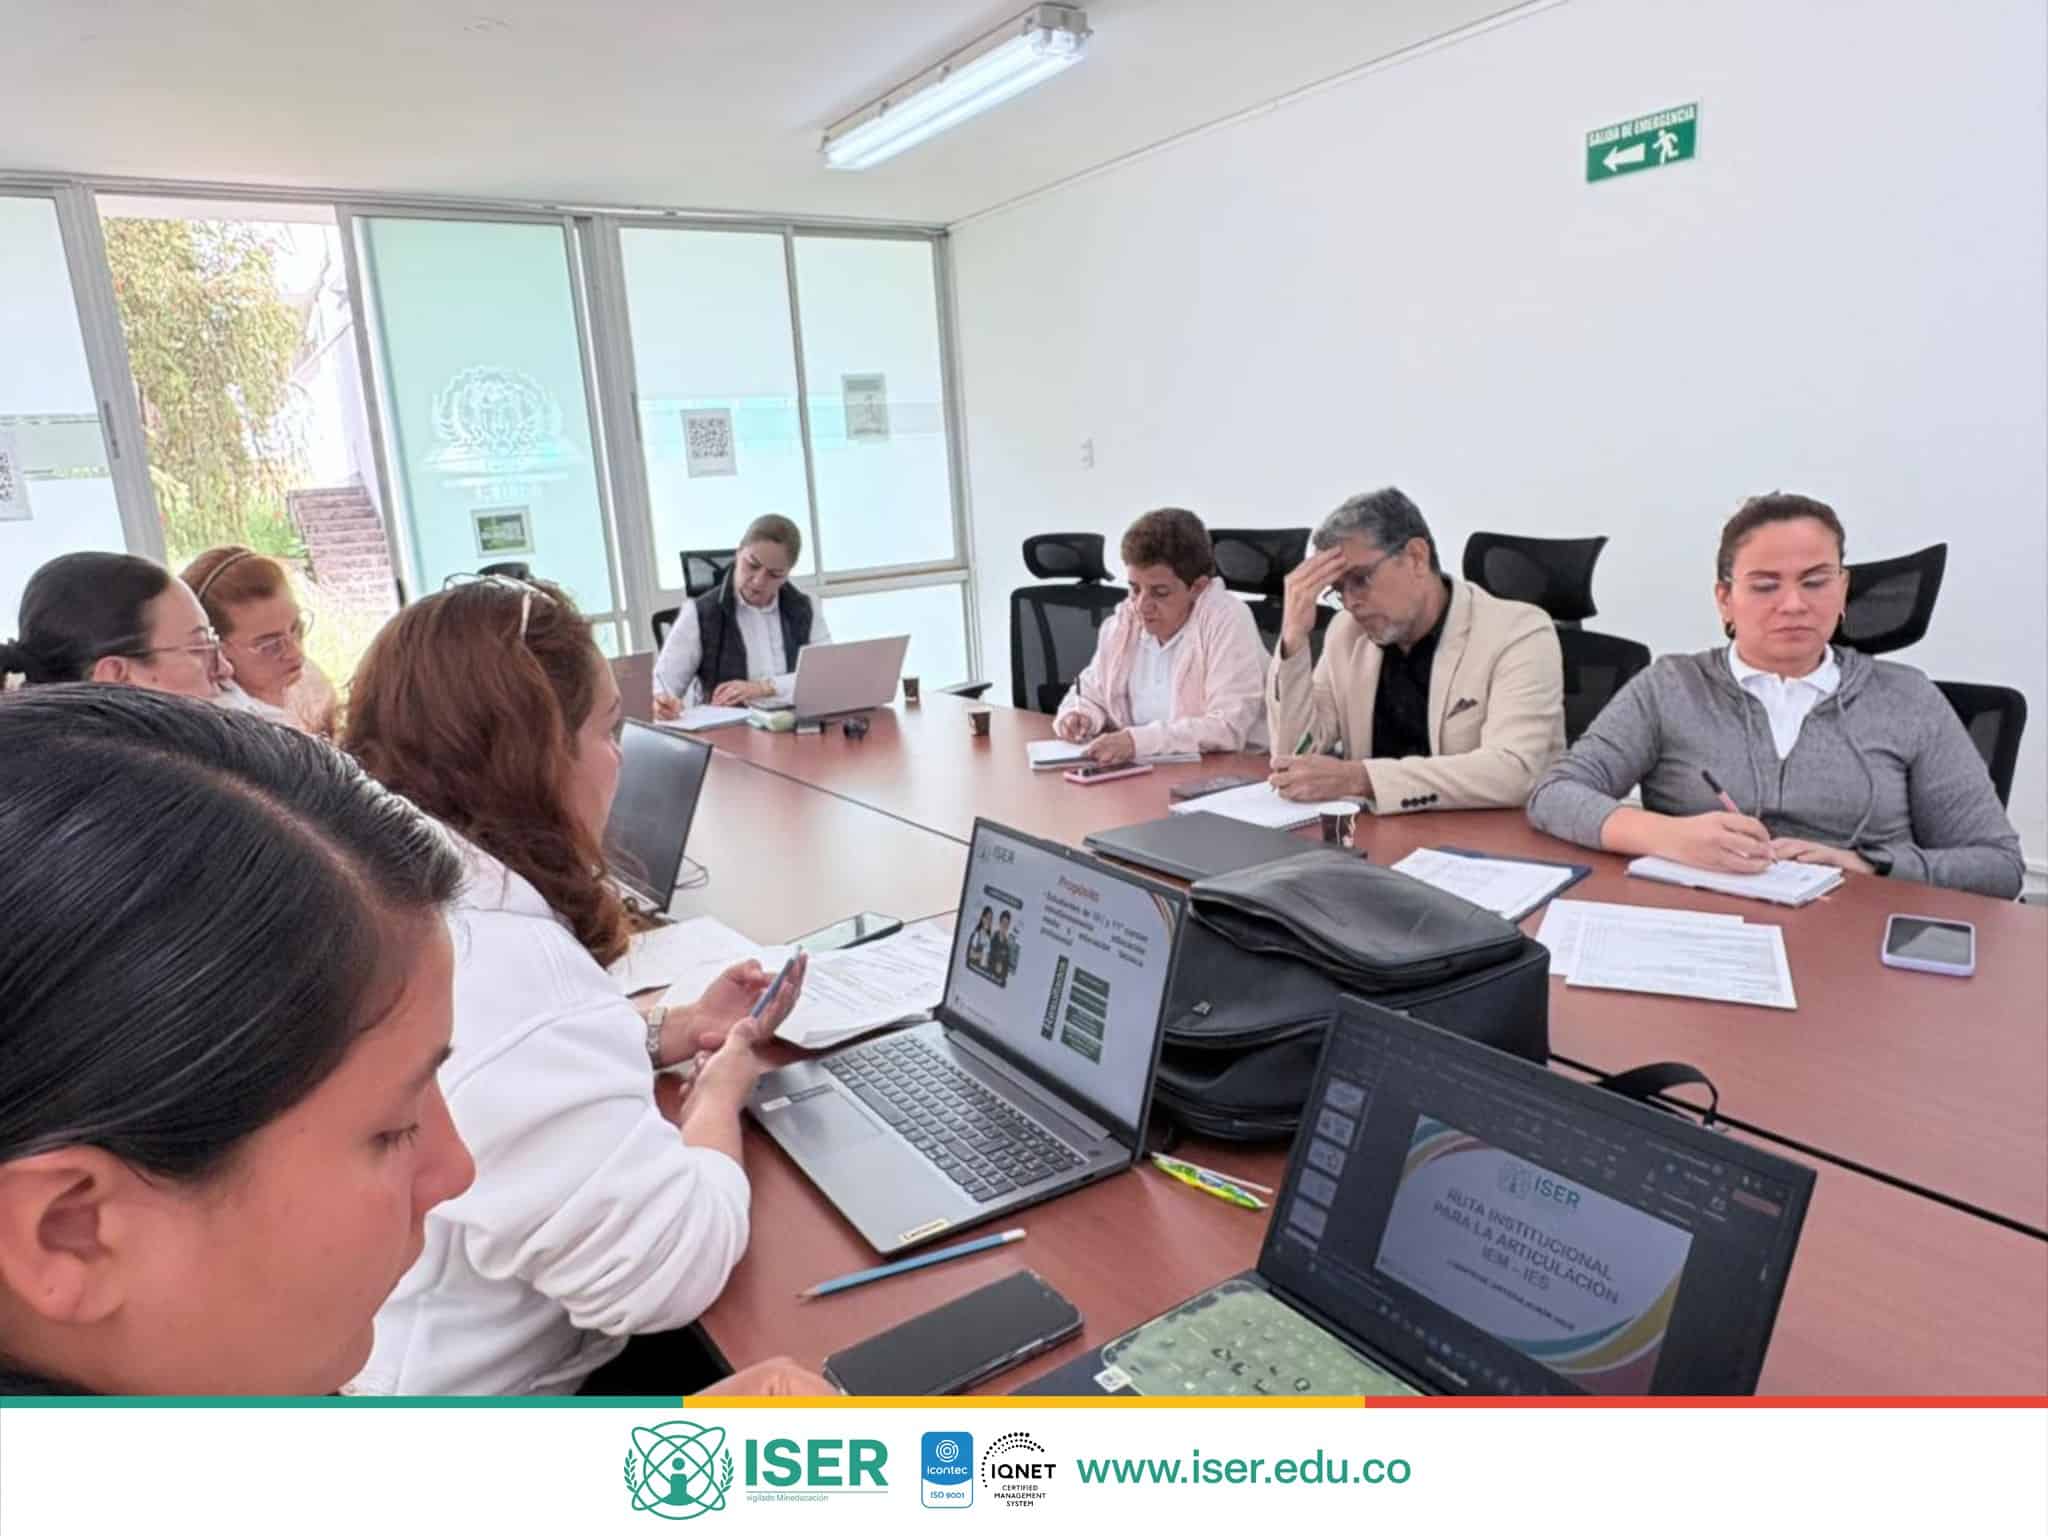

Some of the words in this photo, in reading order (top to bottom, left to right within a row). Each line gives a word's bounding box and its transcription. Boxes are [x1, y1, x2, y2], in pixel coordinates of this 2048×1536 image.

[1447, 1187, 1485, 1217] RUTA
[1487, 1207, 1613, 1281] INSTITUCIONAL
[1534, 1175, 1581, 1209] ISER
[1433, 1200, 1470, 1229] PARA
[1473, 1221, 1493, 1241] LA
[1495, 1233, 1619, 1304] ARTICULACIÓN
